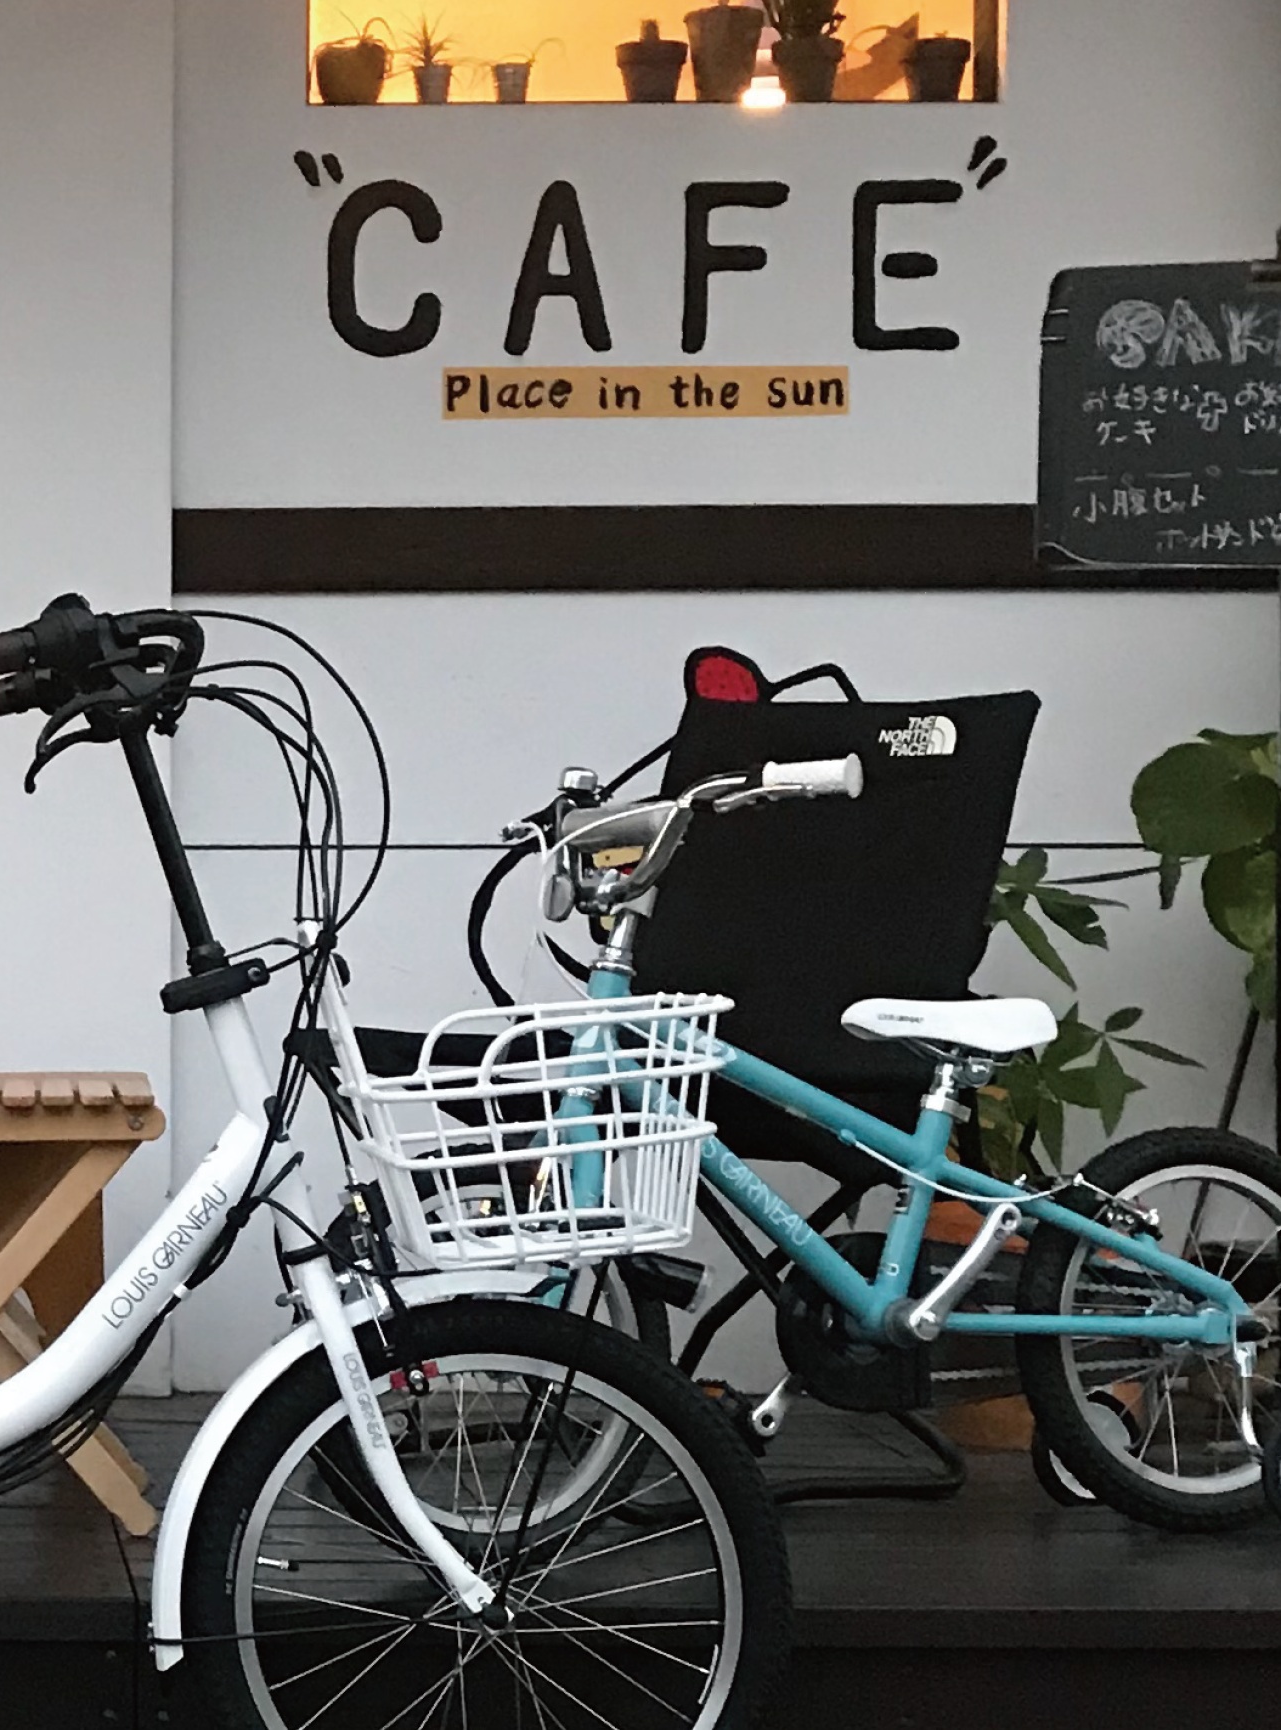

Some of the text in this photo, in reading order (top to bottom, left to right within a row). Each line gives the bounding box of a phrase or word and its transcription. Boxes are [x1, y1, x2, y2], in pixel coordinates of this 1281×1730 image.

[446, 373, 573, 413] Place
[598, 376, 641, 411] in
[668, 374, 740, 409] the
[878, 728, 932, 743] NORTH
[908, 716, 936, 730] THE
[889, 743, 927, 757] FACE
[720, 1151, 814, 1246] GARNEAU
[101, 1182, 228, 1330] LOUIS GARNEAU
